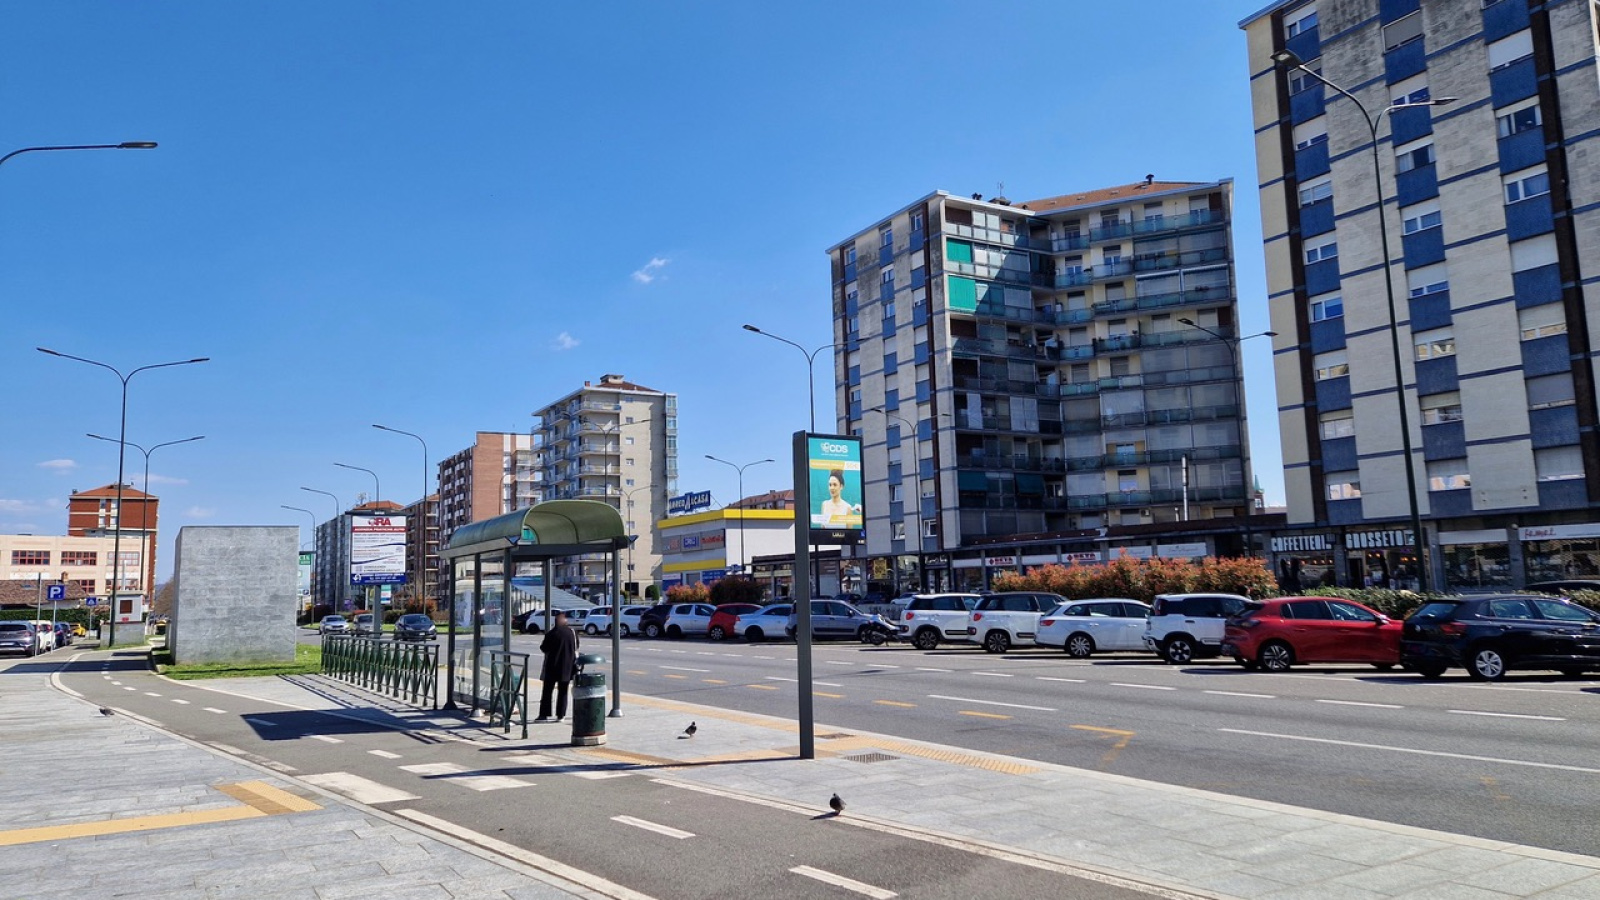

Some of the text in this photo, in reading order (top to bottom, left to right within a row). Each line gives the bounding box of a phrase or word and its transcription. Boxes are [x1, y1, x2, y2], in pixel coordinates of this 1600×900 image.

[830, 444, 848, 454] CDS
[1345, 530, 1404, 549] GROSSETO
[50, 586, 61, 598] P
